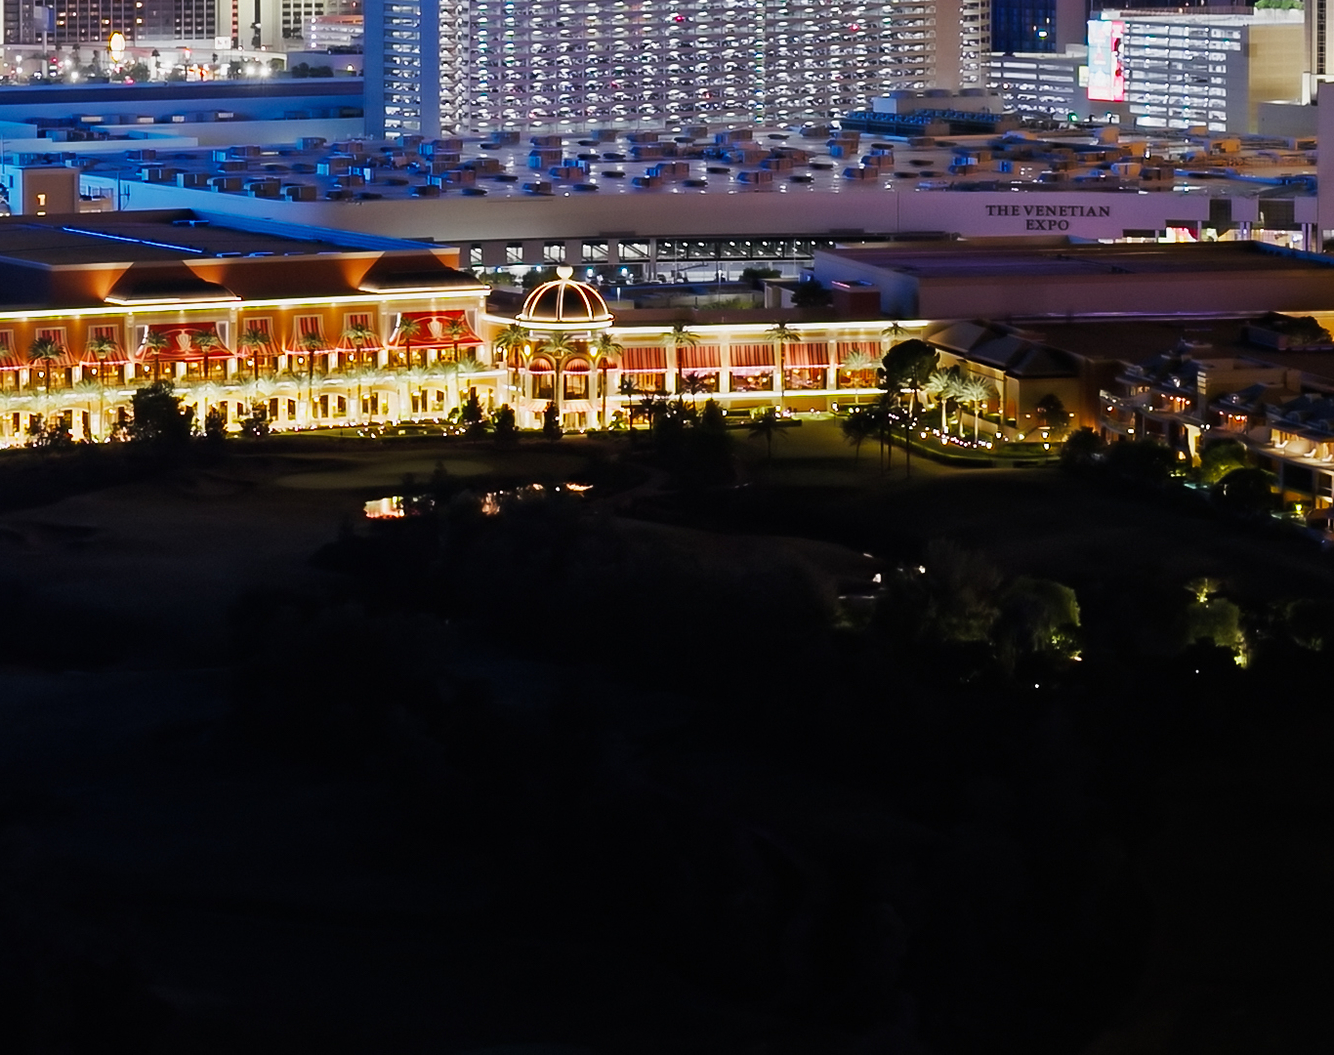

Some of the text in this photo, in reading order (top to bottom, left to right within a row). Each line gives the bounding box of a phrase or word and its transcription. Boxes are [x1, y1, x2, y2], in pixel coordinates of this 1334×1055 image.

[985, 205, 1110, 217] THE VENETIAN
[1025, 219, 1070, 231] EXPO
